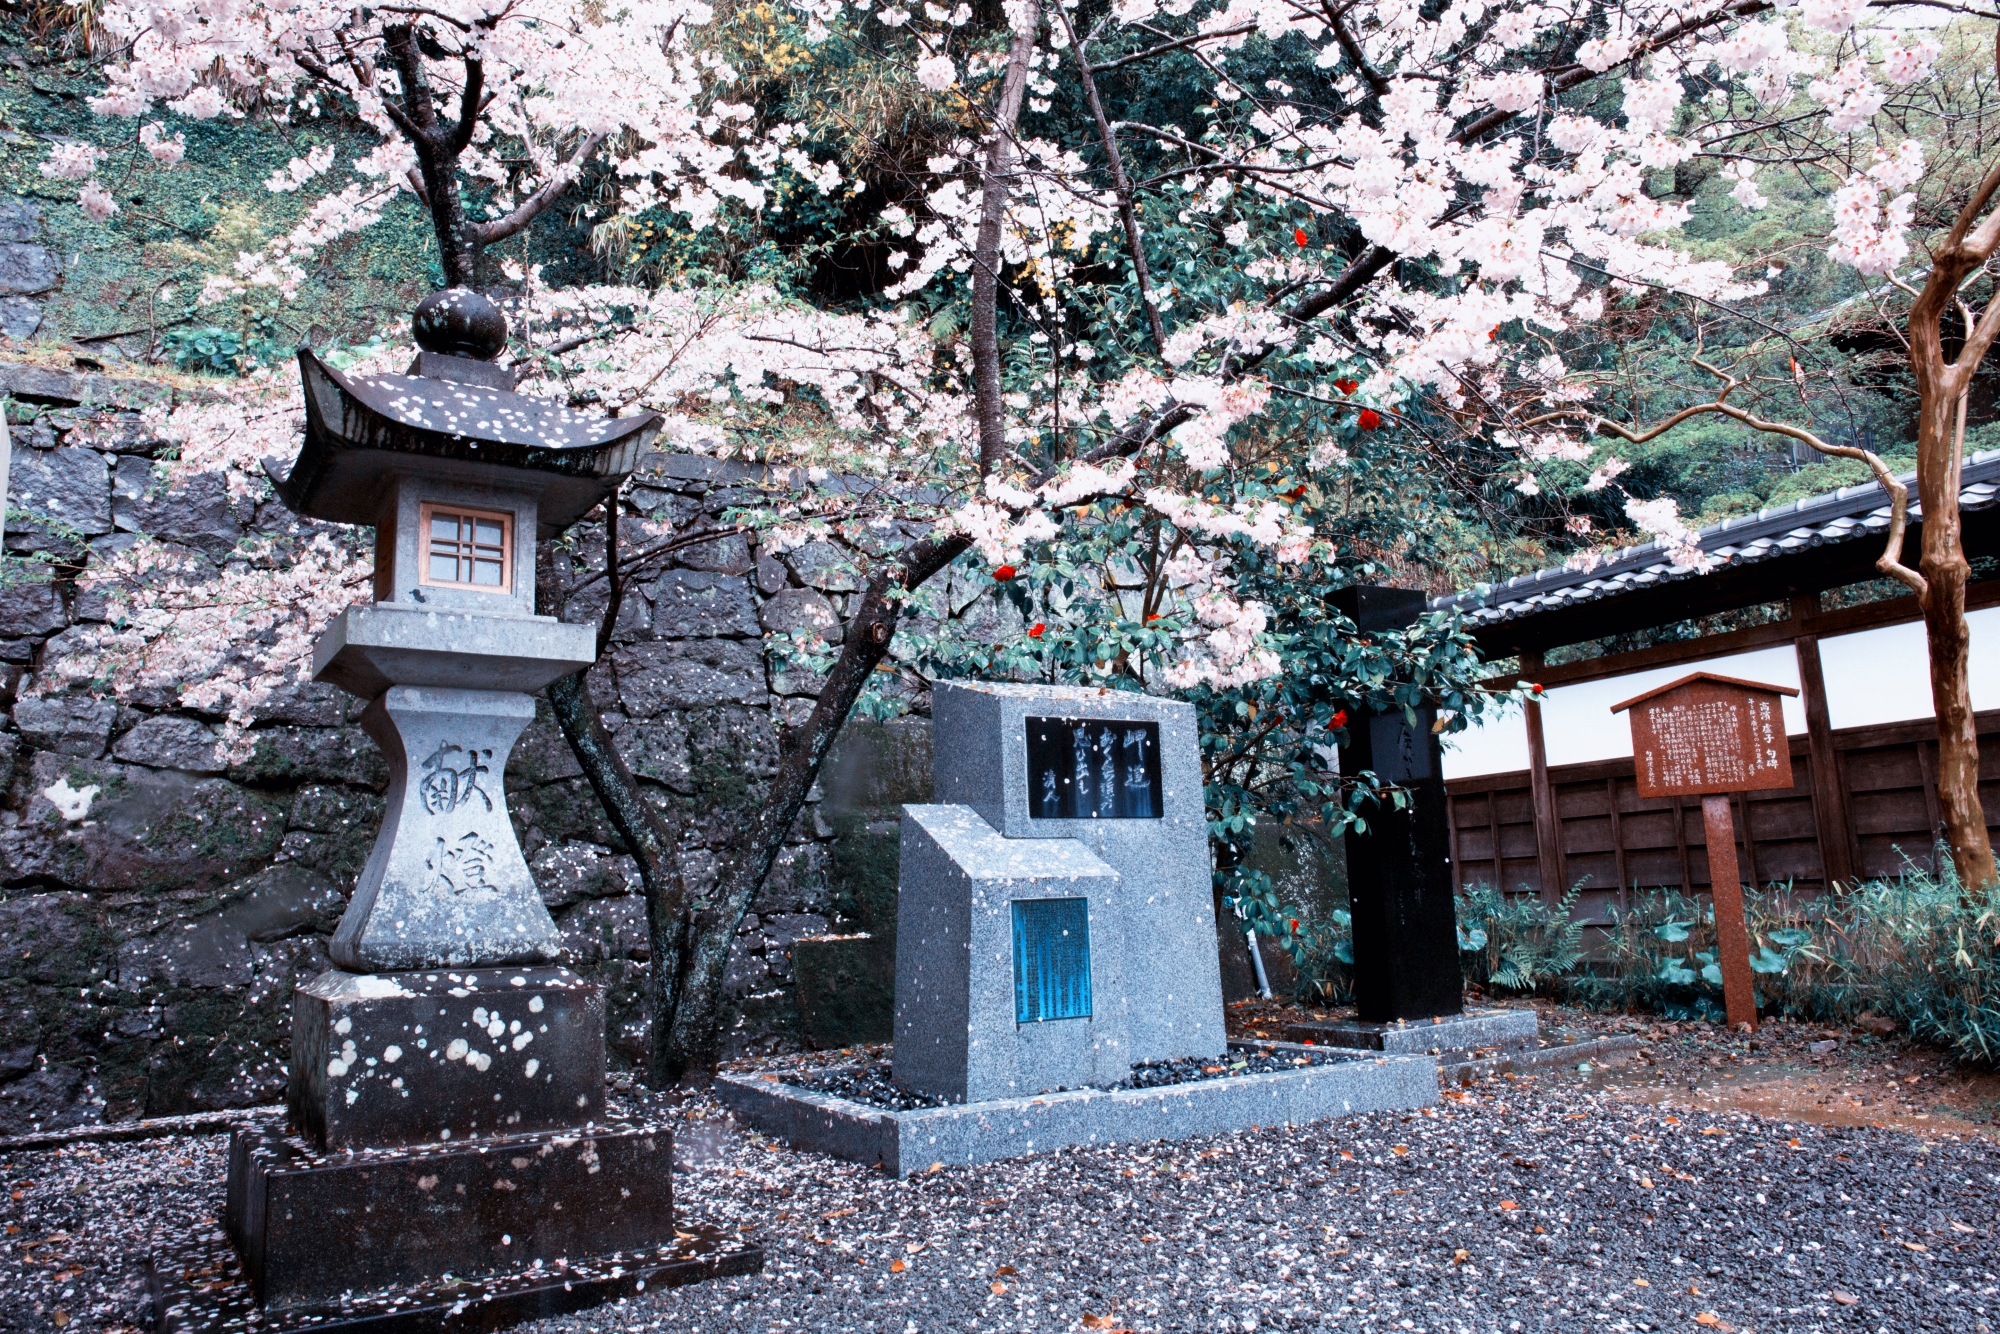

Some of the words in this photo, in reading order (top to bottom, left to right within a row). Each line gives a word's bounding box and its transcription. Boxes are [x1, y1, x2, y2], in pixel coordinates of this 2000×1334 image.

[1123, 728, 1151, 788] 岬道
[1766, 748, 1779, 769] 句碑
[419, 738, 499, 896] 献燈
